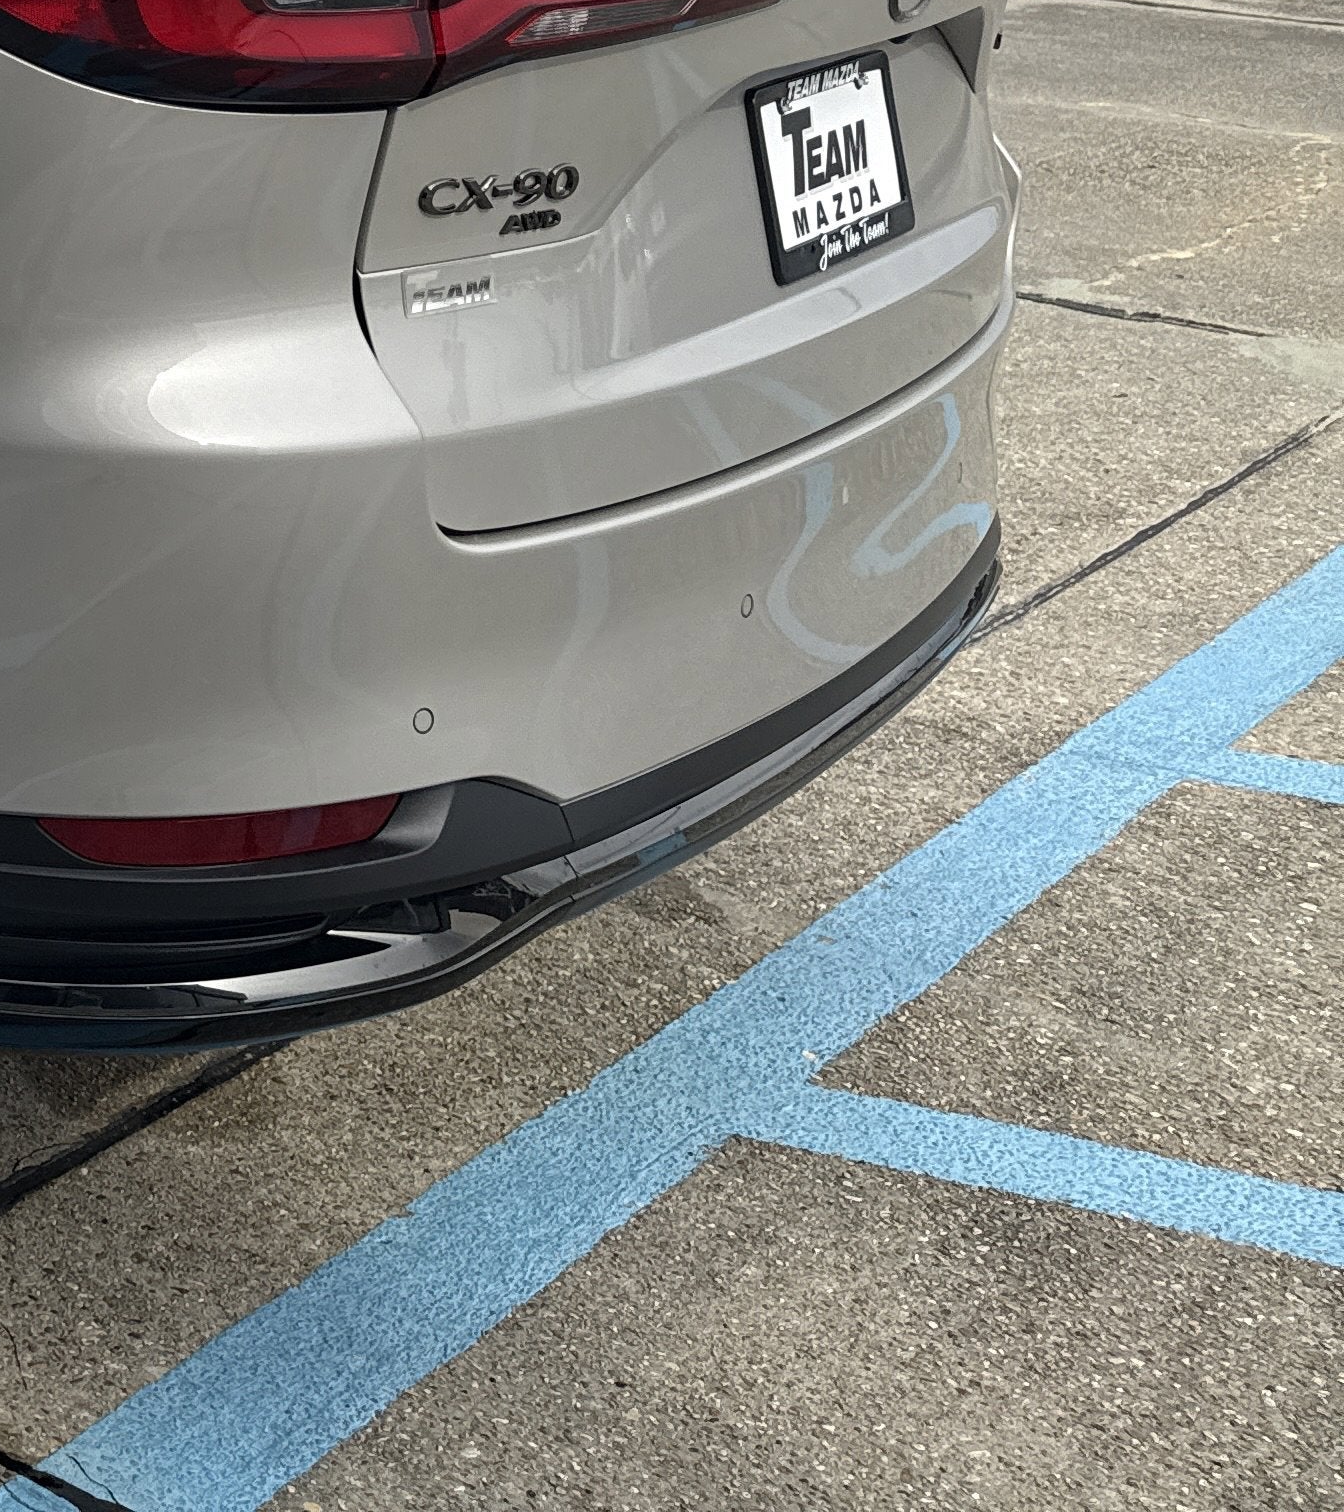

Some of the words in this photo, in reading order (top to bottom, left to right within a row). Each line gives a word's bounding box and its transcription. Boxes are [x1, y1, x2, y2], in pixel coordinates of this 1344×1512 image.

[787, 72, 821, 102] TEAM
[821, 61, 860, 93] MAZDA
[781, 106, 868, 197] TEAM
[418, 162, 580, 216] CX-90
[792, 179, 881, 238] MAZDA
[499, 208, 562, 235] AWD
[819, 233, 843, 272] Join
[840, 224, 861, 253] The
[858, 211, 889, 245] Team!
